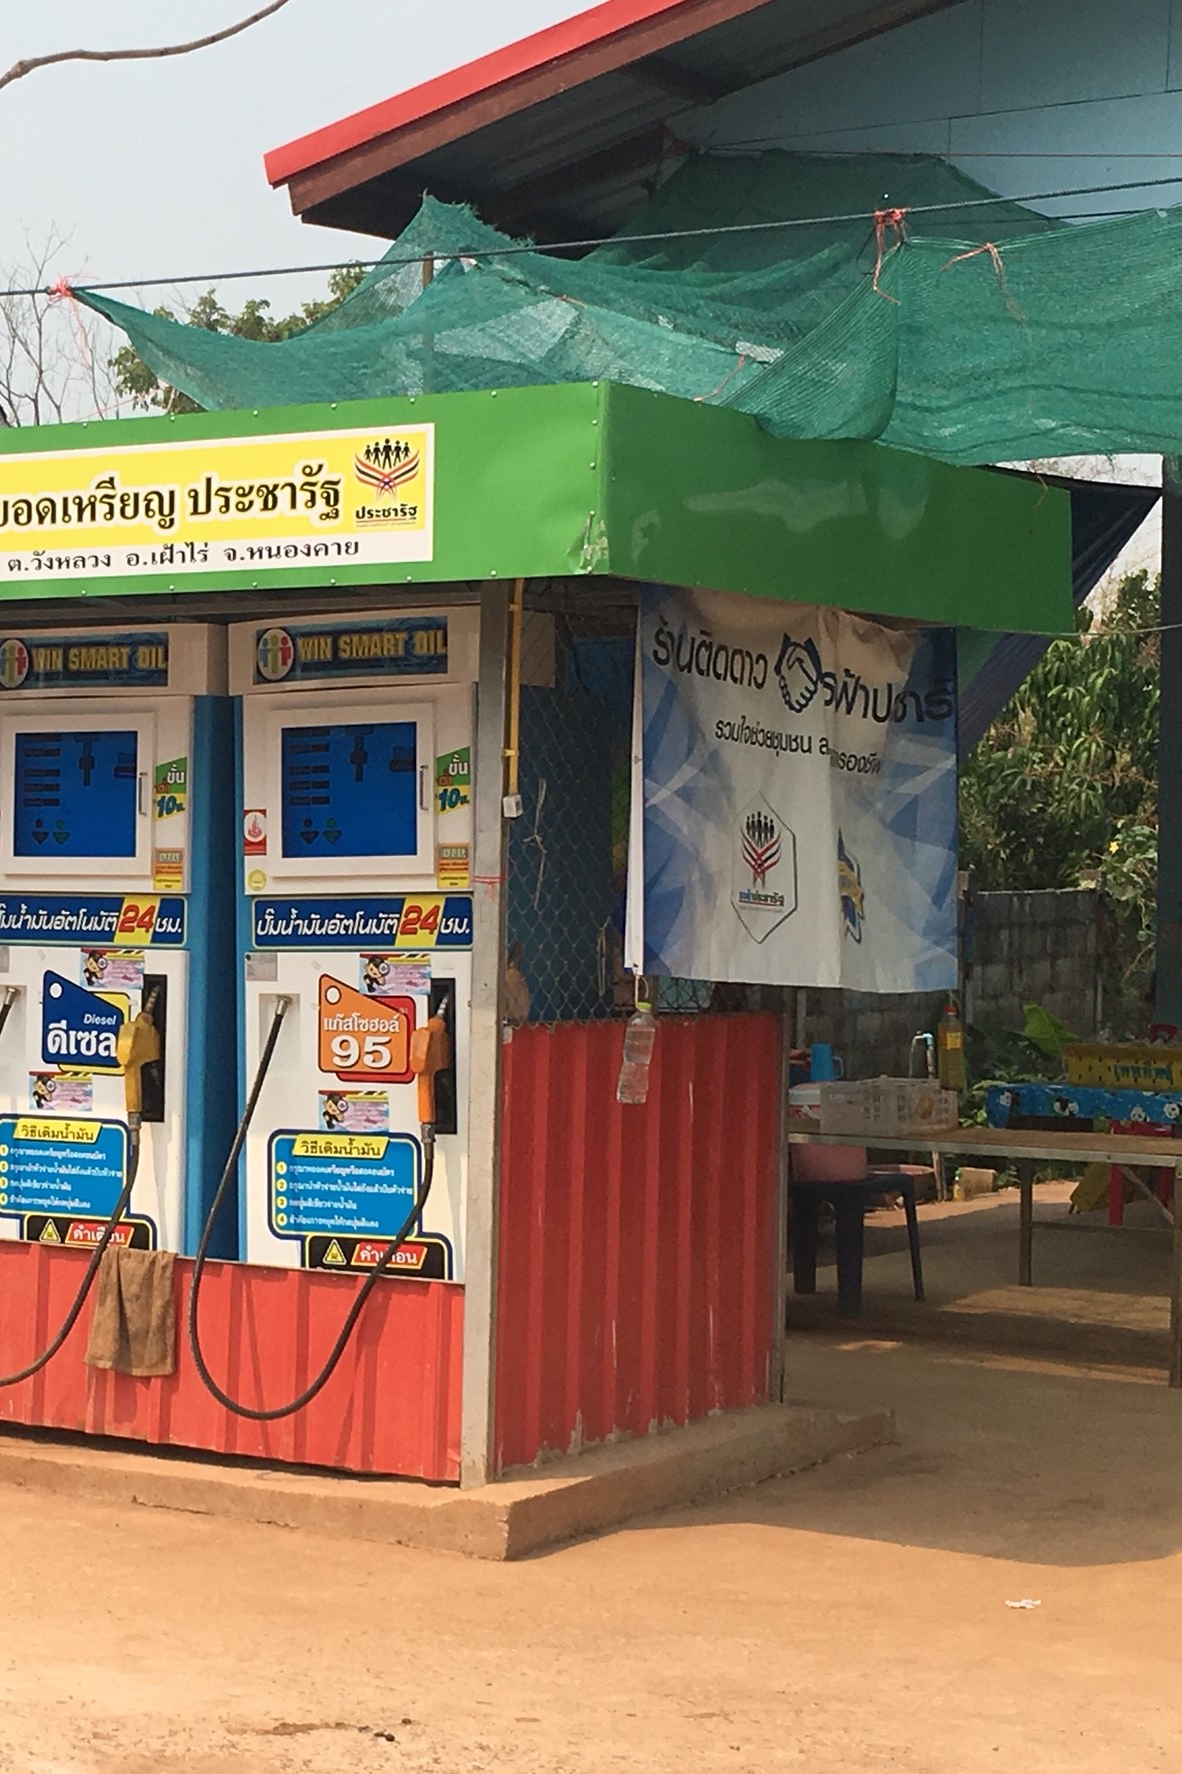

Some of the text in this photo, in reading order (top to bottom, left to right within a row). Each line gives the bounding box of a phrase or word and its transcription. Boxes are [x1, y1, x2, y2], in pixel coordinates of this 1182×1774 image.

[188, 463, 341, 521] ประชารัฐ
[355, 503, 418, 520] ประชารัฐ
[7, 549, 112, 573] ต.วังหลวง
[125, 541, 209, 567] อ.เฝ้าไร่
[223, 540, 359, 563] จ.หนองคาย
[32, 645, 167, 672] WIN SMART OIL
[297, 629, 448, 662] WIN SMART OIL
[118, 904, 156, 934] 24
[155, 915, 182, 934] ชม.
[399, 904, 441, 936] 24
[440, 916, 471, 936] ชม.
[83, 1013, 117, 1026] Diesel
[323, 1011, 402, 1033] แก๊สโซฮอล์
[47, 1019, 118, 1058] ดีเซล
[331, 1034, 392, 1069] 95
